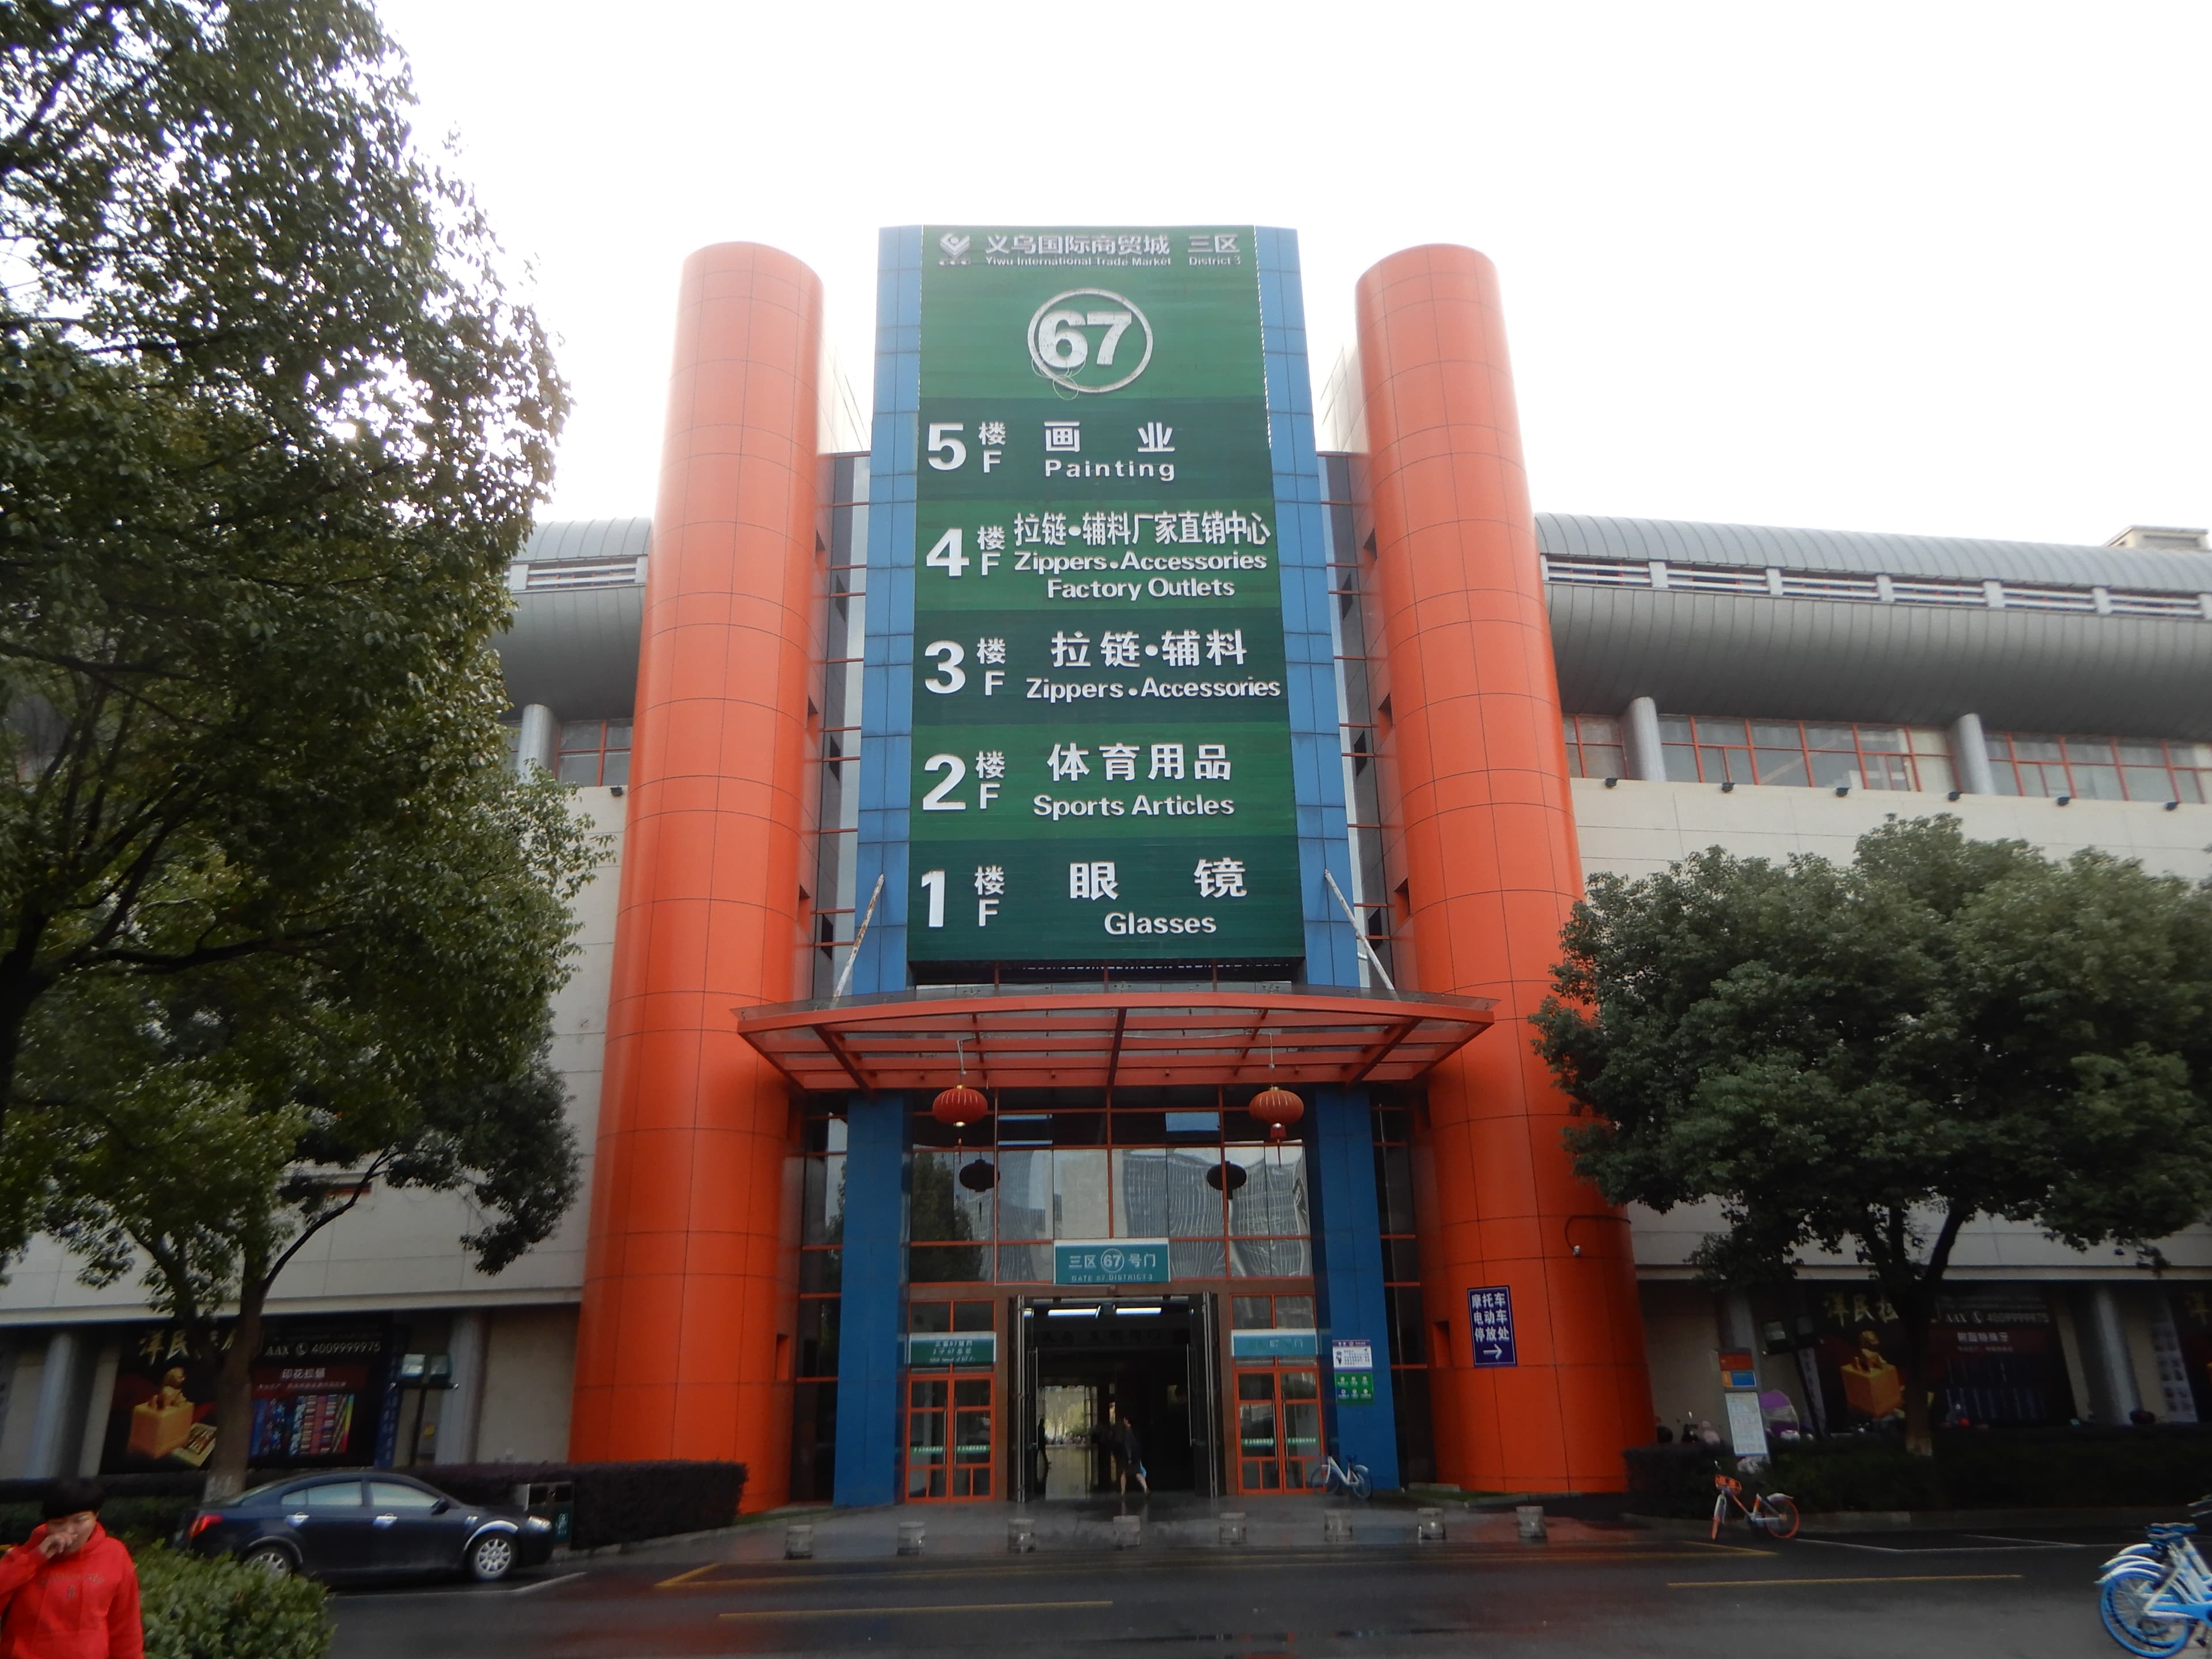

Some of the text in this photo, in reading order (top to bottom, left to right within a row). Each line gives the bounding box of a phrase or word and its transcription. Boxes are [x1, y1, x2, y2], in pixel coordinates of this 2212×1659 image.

[986, 234, 1240, 255] 义乌国际商贸城 三区
[986, 256, 1014, 266] Yiwu
[1017, 256, 1091, 266] International
[1096, 257, 1128, 266] Trade
[1132, 256, 1171, 266] Market
[1188, 256, 1231, 266] District
[1038, 310, 1132, 368] 67
[978, 421, 1006, 445] 楼
[928, 422, 967, 471] 5
[983, 449, 1002, 474] F
[1045, 460, 1175, 482] Painting
[977, 525, 1005, 550] 楼
[926, 528, 969, 577] 4
[982, 552, 1001, 576] F
[1047, 577, 1235, 601] Factory Outlets
[977, 637, 1006, 665] 楼
[925, 640, 966, 694] 3
[985, 671, 1005, 696] F
[975, 751, 1005, 779] 楼
[1047, 742, 1232, 782] 体育用品
[922, 753, 966, 810] 2
[979, 782, 1001, 809] F
[1033, 794, 1234, 821] Sports Articles
[974, 865, 1005, 896] 楼
[921, 869, 945, 928] 1
[978, 899, 1000, 927] F
[1104, 911, 1217, 935] Glasses
[1471, 1292, 1506, 1309] 摩托车
[1474, 1309, 1508, 1326] 电动车
[1475, 1325, 1510, 1343] 停放处
